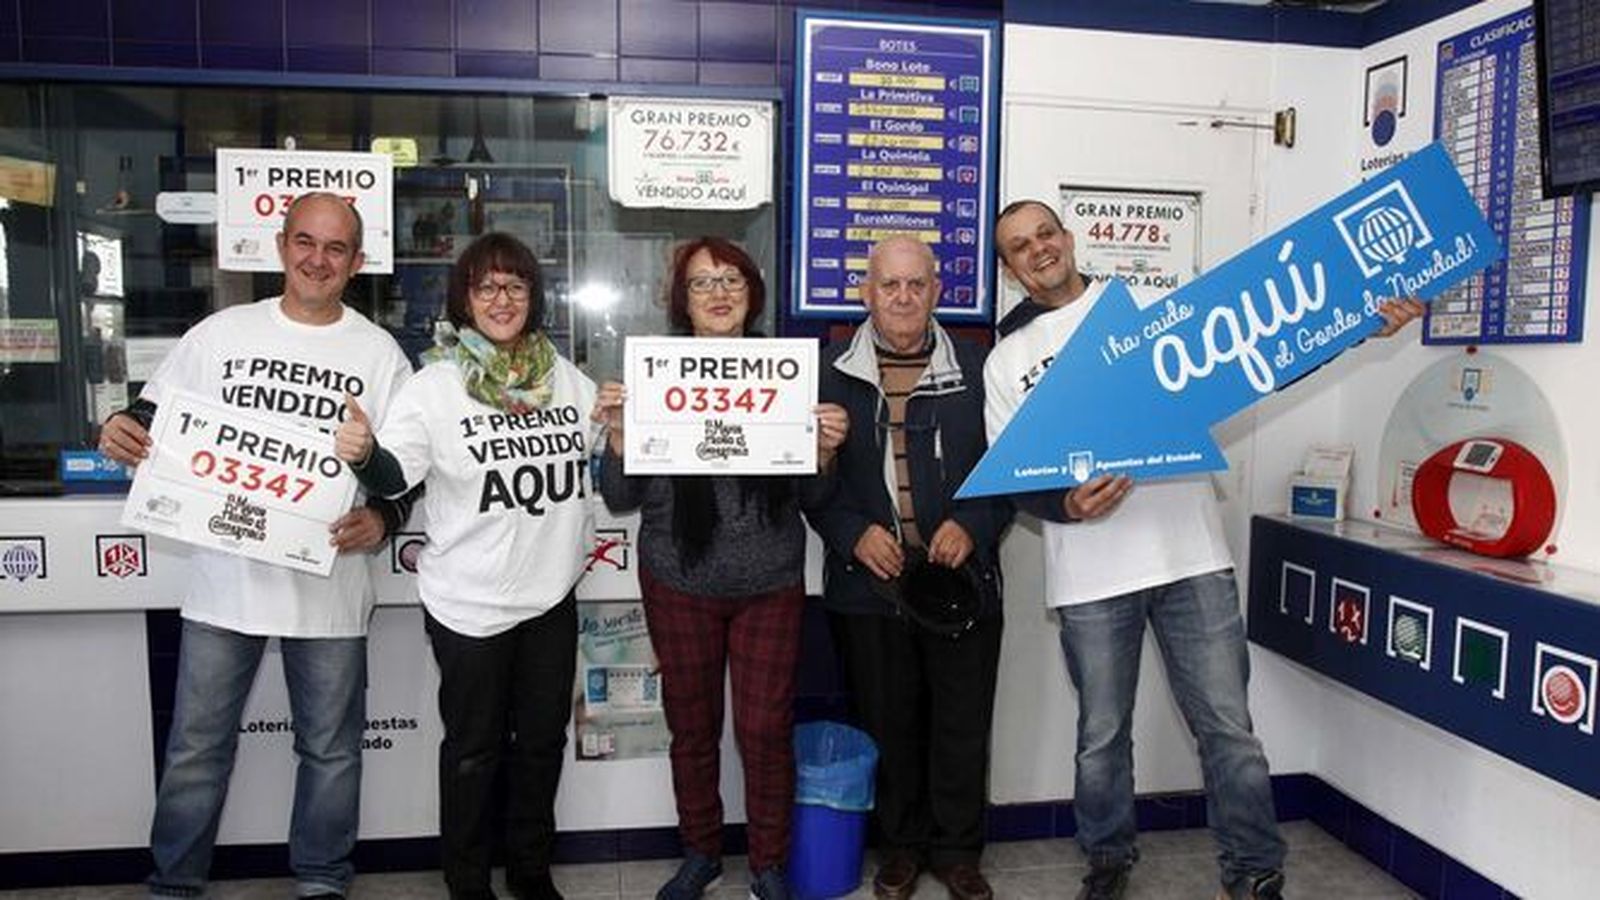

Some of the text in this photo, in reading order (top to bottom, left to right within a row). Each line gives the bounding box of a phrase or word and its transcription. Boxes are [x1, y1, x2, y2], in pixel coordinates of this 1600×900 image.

[880, 40, 918, 52] BOTES
[866, 59, 931, 73] Bono Loto
[861, 89, 934, 103] La Primitiva
[631, 110, 751, 128] GRAN PREMIO
[870, 119, 924, 132] El Gordo
[644, 130, 728, 151] 76.732
[862, 149, 930, 162] La Quiniela
[234, 167, 375, 189] 1er PREMIO
[861, 180, 873, 191] El
[635, 184, 746, 200] VENDIDO AQUÍ
[255, 194, 357, 216] 037
[1075, 203, 1184, 221] GRAN PREMIO
[854, 213, 934, 227] EuroMillones
[1088, 222, 1160, 243] 44.778
[1274, 340, 1294, 369] el
[1296, 307, 1361, 353] Gordo
[1385, 233, 1479, 297] Navidad!
[1153, 240, 1326, 393] aquí
[249, 358, 363, 397] PREMIO
[644, 357, 799, 380] 1er PREMIO
[665, 386, 778, 413] 03347
[488, 405, 579, 432] PREMIO
[180, 412, 341, 477] 1er PREMIO
[467, 431, 585, 464] VENDIDO
[191, 450, 314, 502] 03347
[238, 719, 294, 733] Loteria
